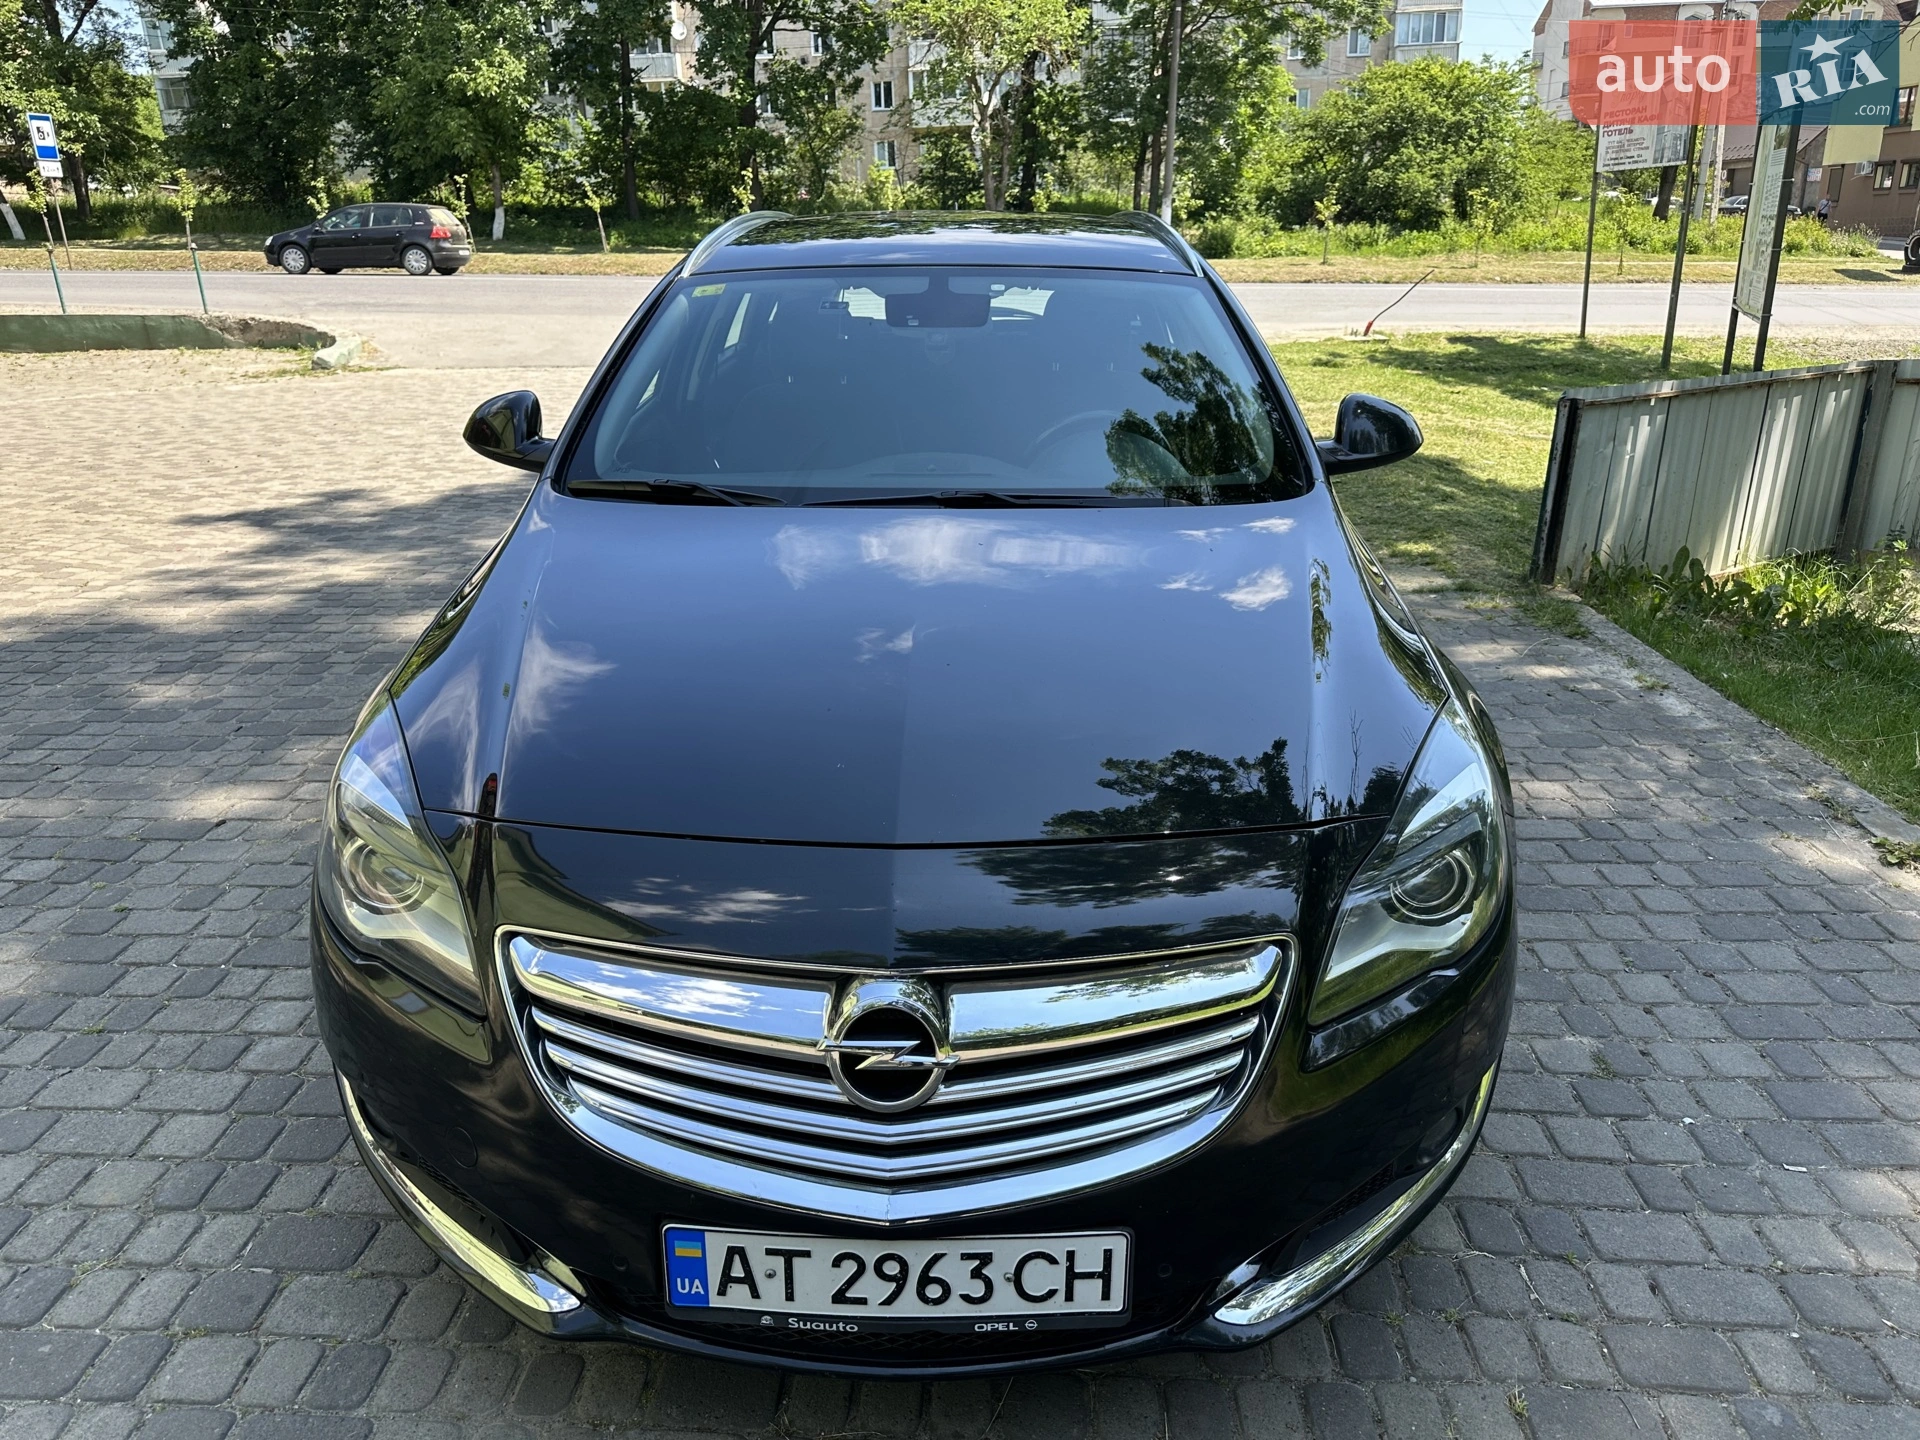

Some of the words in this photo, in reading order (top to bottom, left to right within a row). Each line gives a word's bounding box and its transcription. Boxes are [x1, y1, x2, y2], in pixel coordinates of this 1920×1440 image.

[1603, 105, 1648, 120] РЕСТОРАН
[1602, 127, 1634, 138] ГОТЕЛЬ
[716, 1244, 812, 1302] AT
[830, 1250, 994, 1307] 2963
[1012, 1247, 1113, 1304] CH
[676, 1277, 705, 1295] UA
[787, 1317, 859, 1333] Suauto
[974, 1322, 1019, 1332] OPEL
